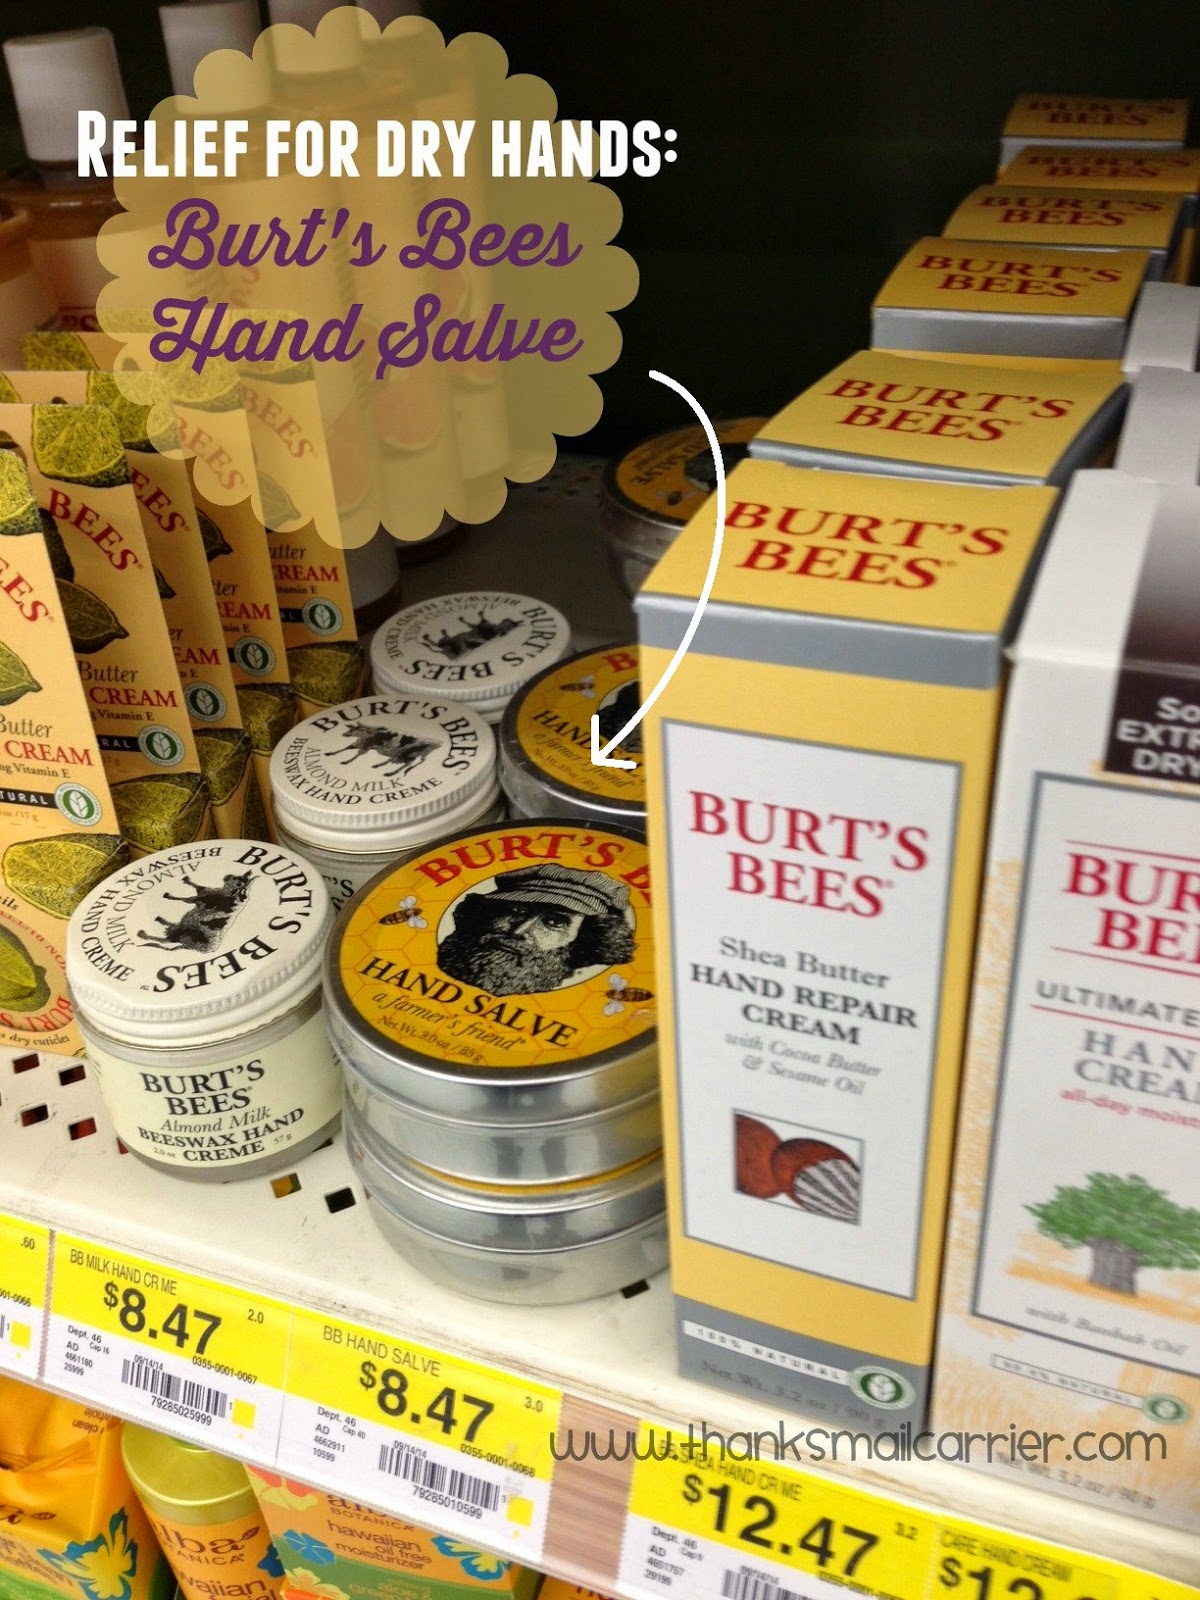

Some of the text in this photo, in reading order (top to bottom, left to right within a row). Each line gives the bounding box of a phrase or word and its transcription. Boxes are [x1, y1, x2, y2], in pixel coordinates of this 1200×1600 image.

[997, 208, 1127, 227] BEES
[917, 254, 1122, 284] BURT'S
[936, 273, 1084, 299] BEES
[825, 378, 1076, 419] BURT'S
[836, 403, 1010, 442] BEES
[49, 488, 139, 572] BEES
[716, 500, 1011, 558] BURT'S
[734, 538, 945, 591] BEES
[502, 606, 558, 668] BURT'S
[405, 658, 495, 682] BEES
[89, 686, 179, 708] CREAM
[98, 709, 142, 720] Vitamin
[4, 740, 94, 766] CREAM
[310, 700, 448, 733] BURT'S
[440, 716, 480, 772] BEES
[13, 763, 59, 778] Vitamin
[283, 736, 444, 805] BEESWAX HAND CREME
[302, 746, 405, 792] ALMOND MILK
[688, 789, 931, 872] BURT'S
[415, 833, 624, 888] BURT'S
[727, 851, 886, 918] BEES
[80, 846, 225, 982] BEESWAX HAND CREME
[107, 860, 201, 953] ALMOND MILK
[153, 845, 314, 993] BURT'S BEES
[1091, 907, 1200, 964] BE
[719, 935, 891, 989] Shea Butter
[359, 957, 578, 1047] HAND SALVE
[373, 990, 384, 1003] a
[382, 994, 462, 1031] farmer's
[689, 962, 920, 1029] HAND REPAIR
[10, 1033, 71, 1046] dry cuticles
[741, 1003, 862, 1046] CREAM
[139, 1059, 265, 1096] BURT'S
[1073, 1058, 1200, 1105] CREA
[160, 1105, 272, 1133] Almond Milk
[164, 1087, 252, 1116] BEES
[136, 1107, 305, 1149] BEESWAX HAND
[182, 1140, 265, 1163] CREME
[70, 1248, 177, 1296] BB MILK HAND CR ME
[103, 1280, 222, 1356] $8.47
[247, 1308, 264, 1325] 2.0
[66, 1340, 80, 1352] AD
[91, 1333, 102, 1344] 46
[323, 1324, 442, 1378] BB HAND SALVE
[150, 1394, 213, 1427] 79285025999
[317, 1406, 357, 1428] Dept. 46
[358, 1359, 495, 1443] $8.47
[524, 1395, 544, 1413] 3.0
[315, 1423, 330, 1436] AD
[716, 1460, 757, 1486] HAND
[412, 1484, 483, 1520] 79285010599
[326, 1519, 421, 1552] hawaiian
[681, 1472, 881, 1578] $12.47
[335, 1542, 426, 1571] moisturizer
[397, 1548, 433, 1564] free
